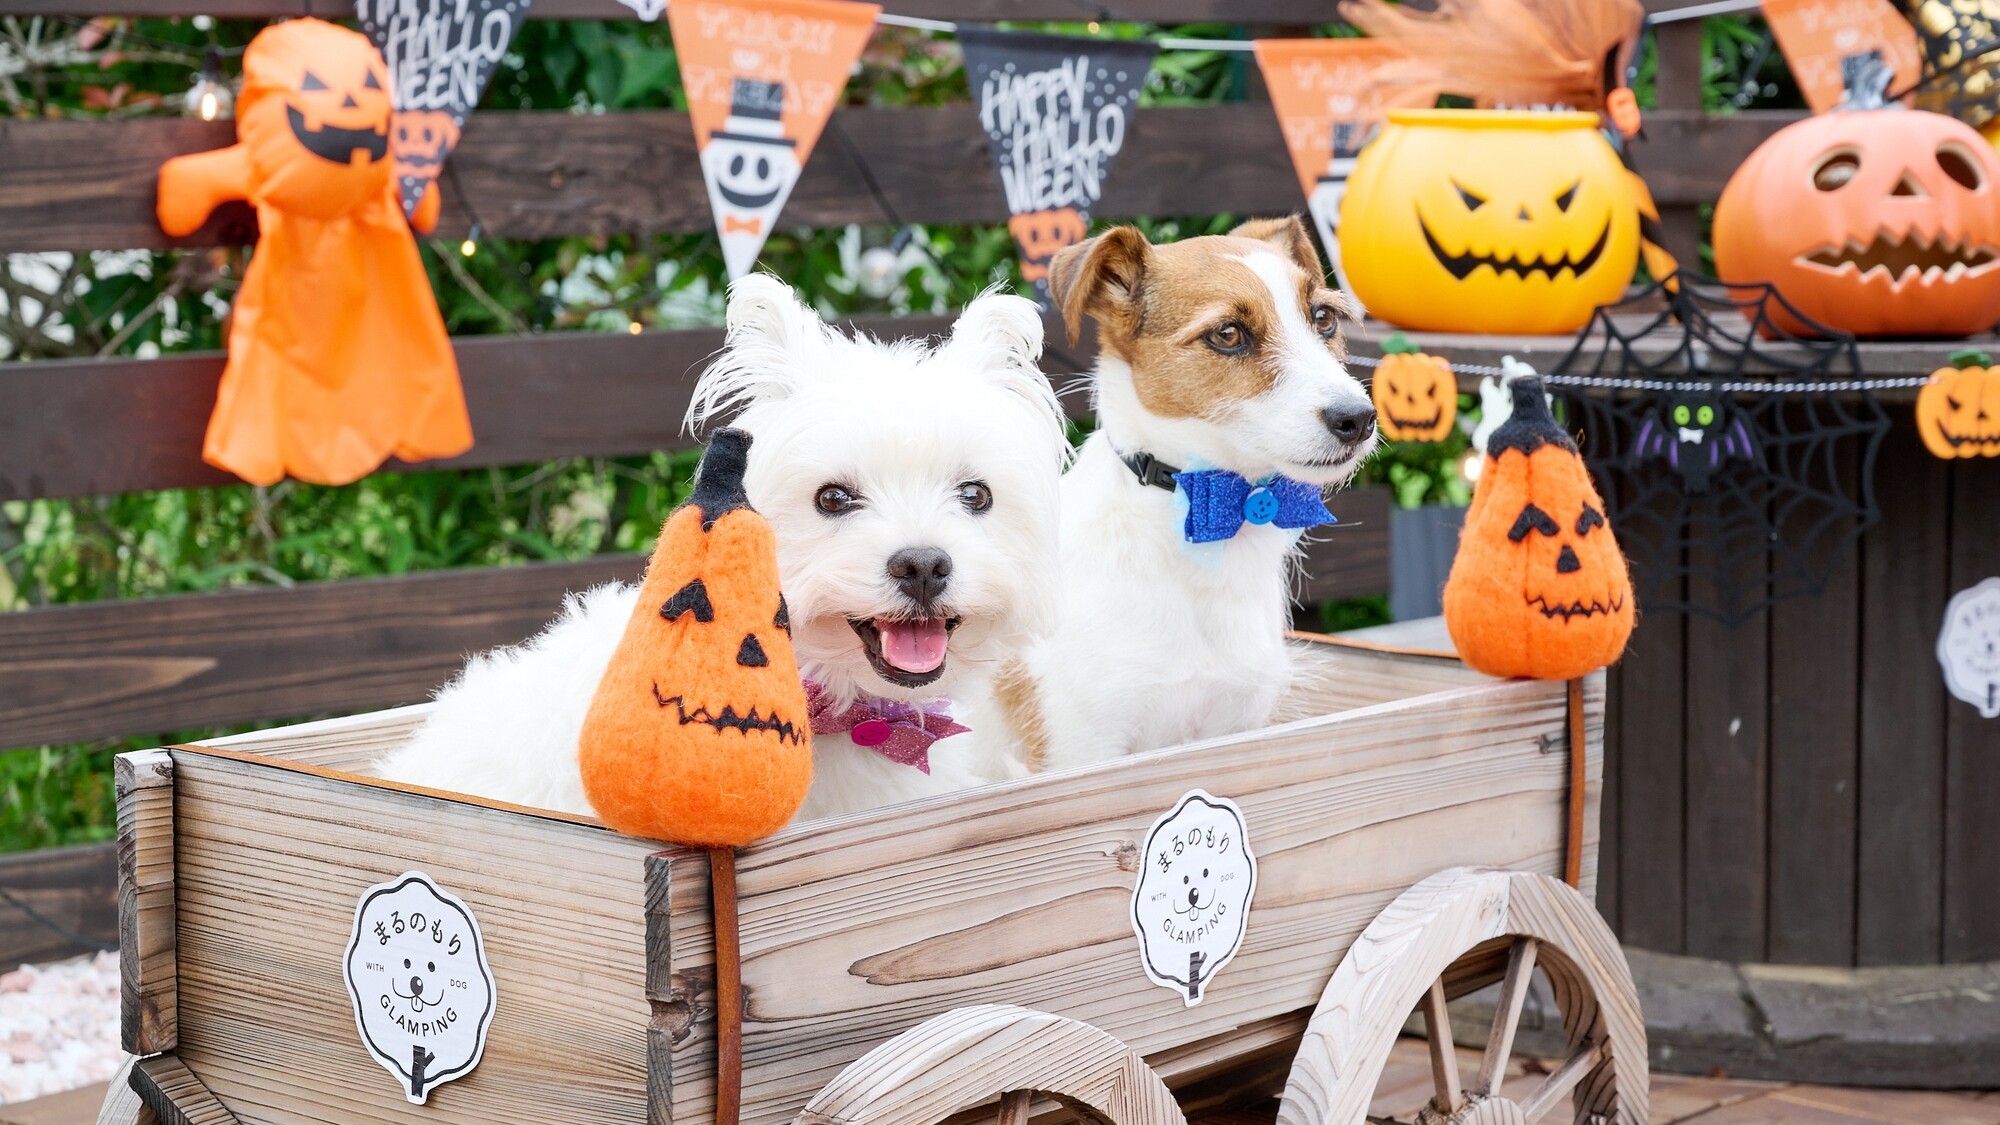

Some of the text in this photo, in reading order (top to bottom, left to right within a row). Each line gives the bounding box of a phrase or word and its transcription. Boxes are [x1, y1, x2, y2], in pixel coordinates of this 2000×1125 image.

[386, 9, 511, 64] HALLO
[980, 55, 1089, 134] HAPPY
[1011, 103, 1125, 167] HALLO
[1001, 156, 1101, 214] WEEN
[1158, 826, 1229, 873] まるのもり
[1151, 872, 1235, 902] WITH DOG
[374, 910, 461, 955] まるのもり
[1162, 902, 1226, 944] GLAMPING
[365, 961, 468, 989] WITH DOG
[380, 994, 458, 1037] GLAMPING
